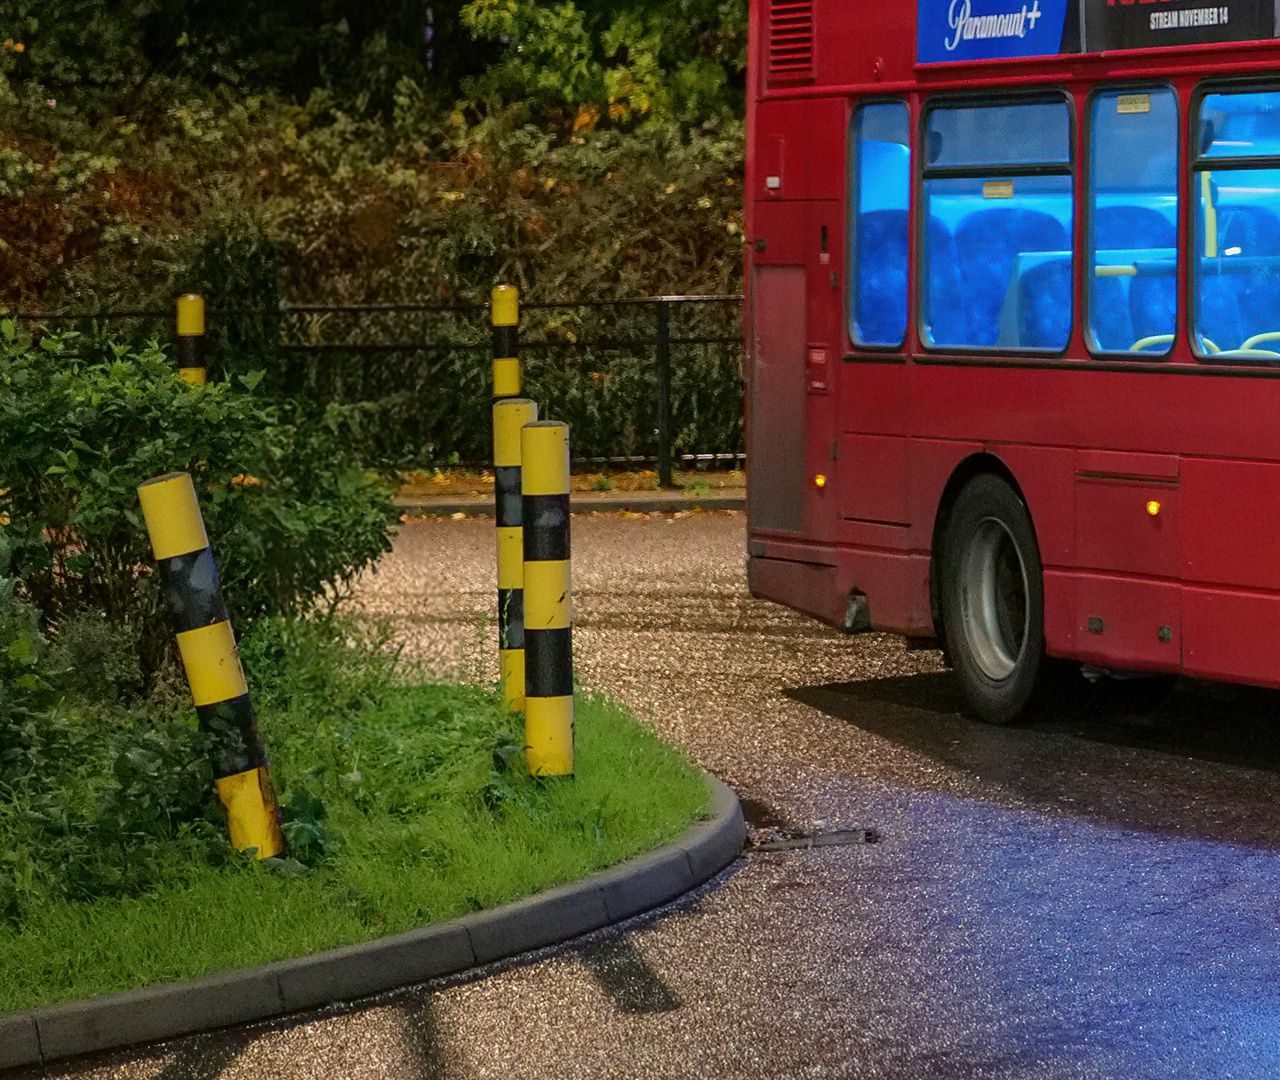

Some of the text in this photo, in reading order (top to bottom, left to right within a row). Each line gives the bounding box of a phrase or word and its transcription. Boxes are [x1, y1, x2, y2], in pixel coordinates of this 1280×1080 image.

[1150, 6, 1228, 30] STREAM NOVEMBER 14
